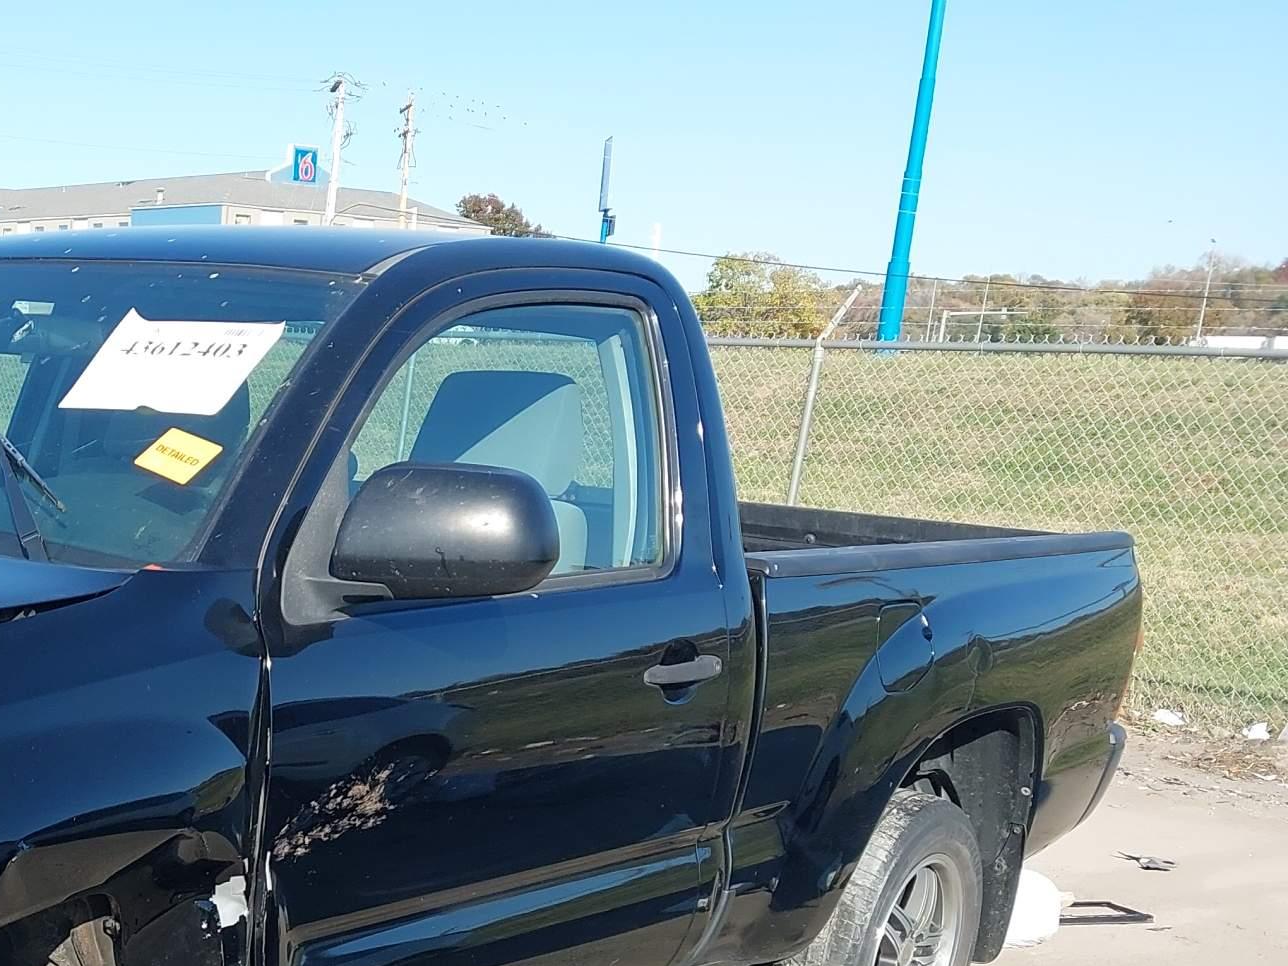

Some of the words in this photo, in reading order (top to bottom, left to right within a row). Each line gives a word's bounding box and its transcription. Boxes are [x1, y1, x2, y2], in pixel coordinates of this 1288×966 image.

[299, 152, 314, 181] 6
[120, 341, 248, 358] 43612403
[156, 443, 200, 466] DETAILED
